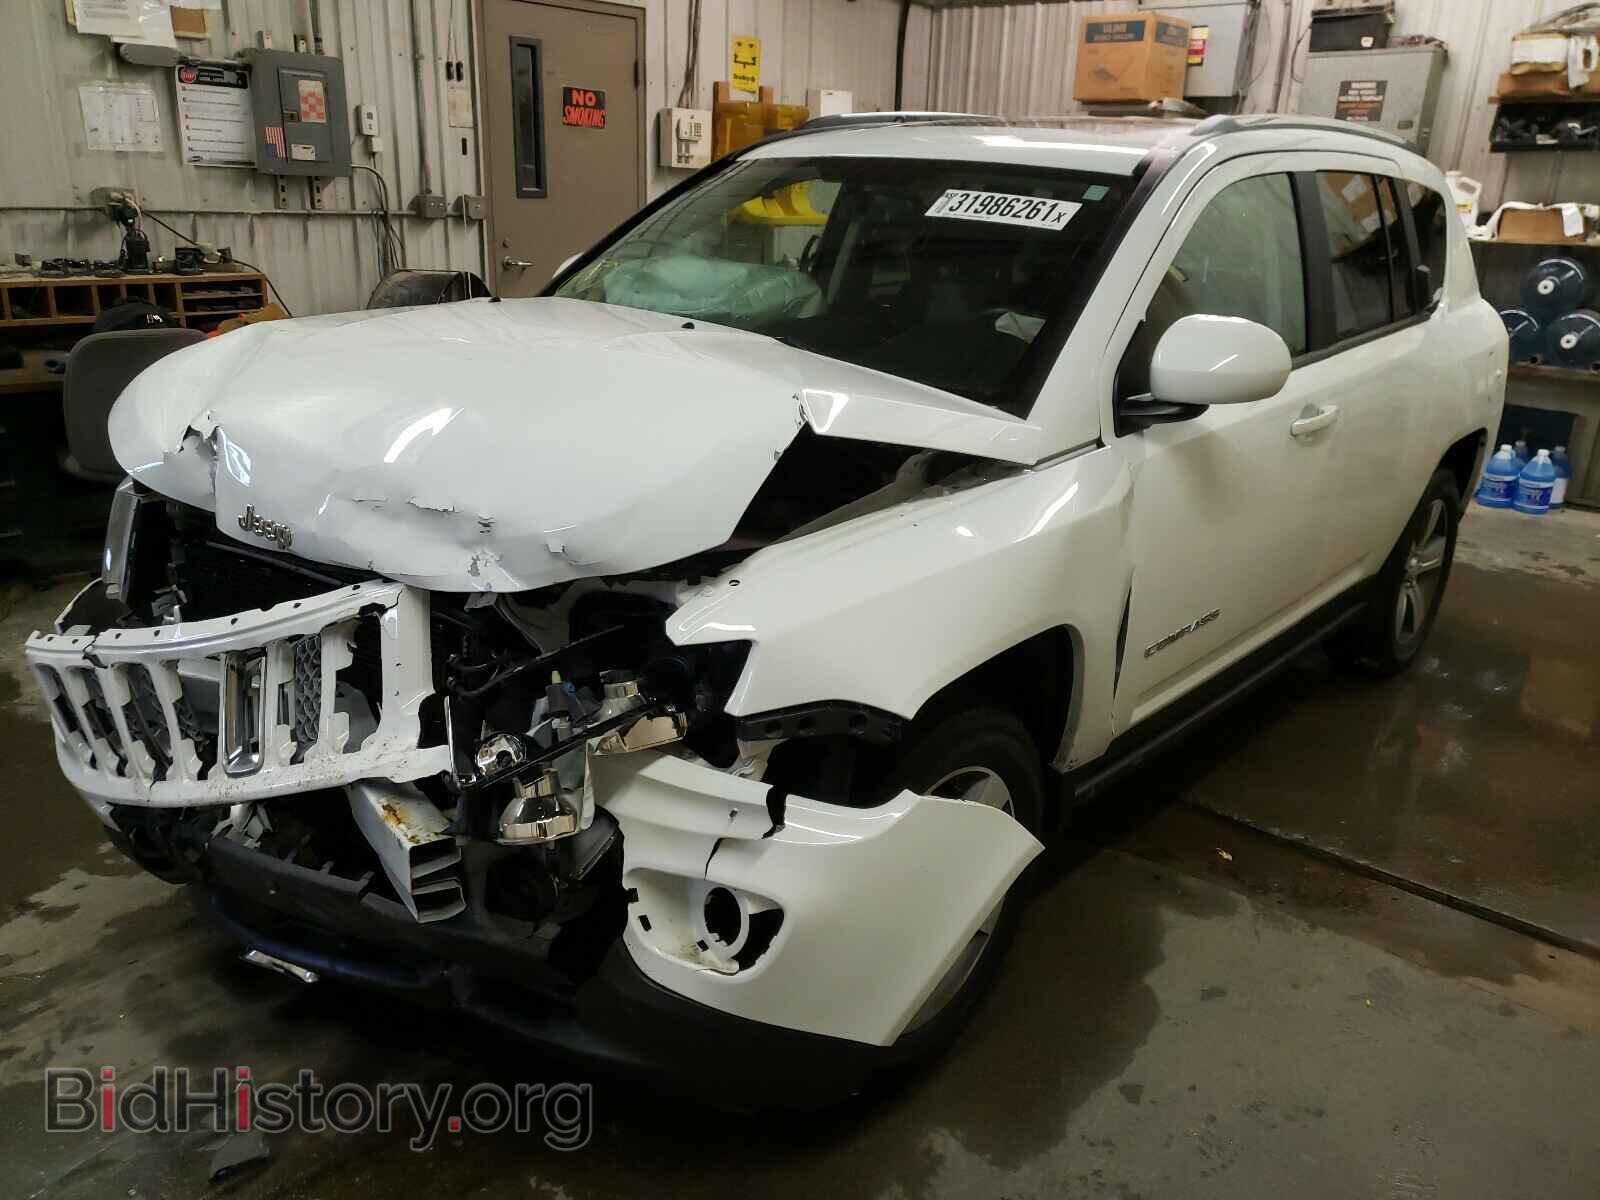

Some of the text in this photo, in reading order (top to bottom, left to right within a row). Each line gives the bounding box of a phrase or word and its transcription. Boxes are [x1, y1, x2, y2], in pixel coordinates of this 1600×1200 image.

[572, 89, 596, 107] NO
[563, 105, 607, 128] SMOKING
[238, 504, 292, 549] Jeep
